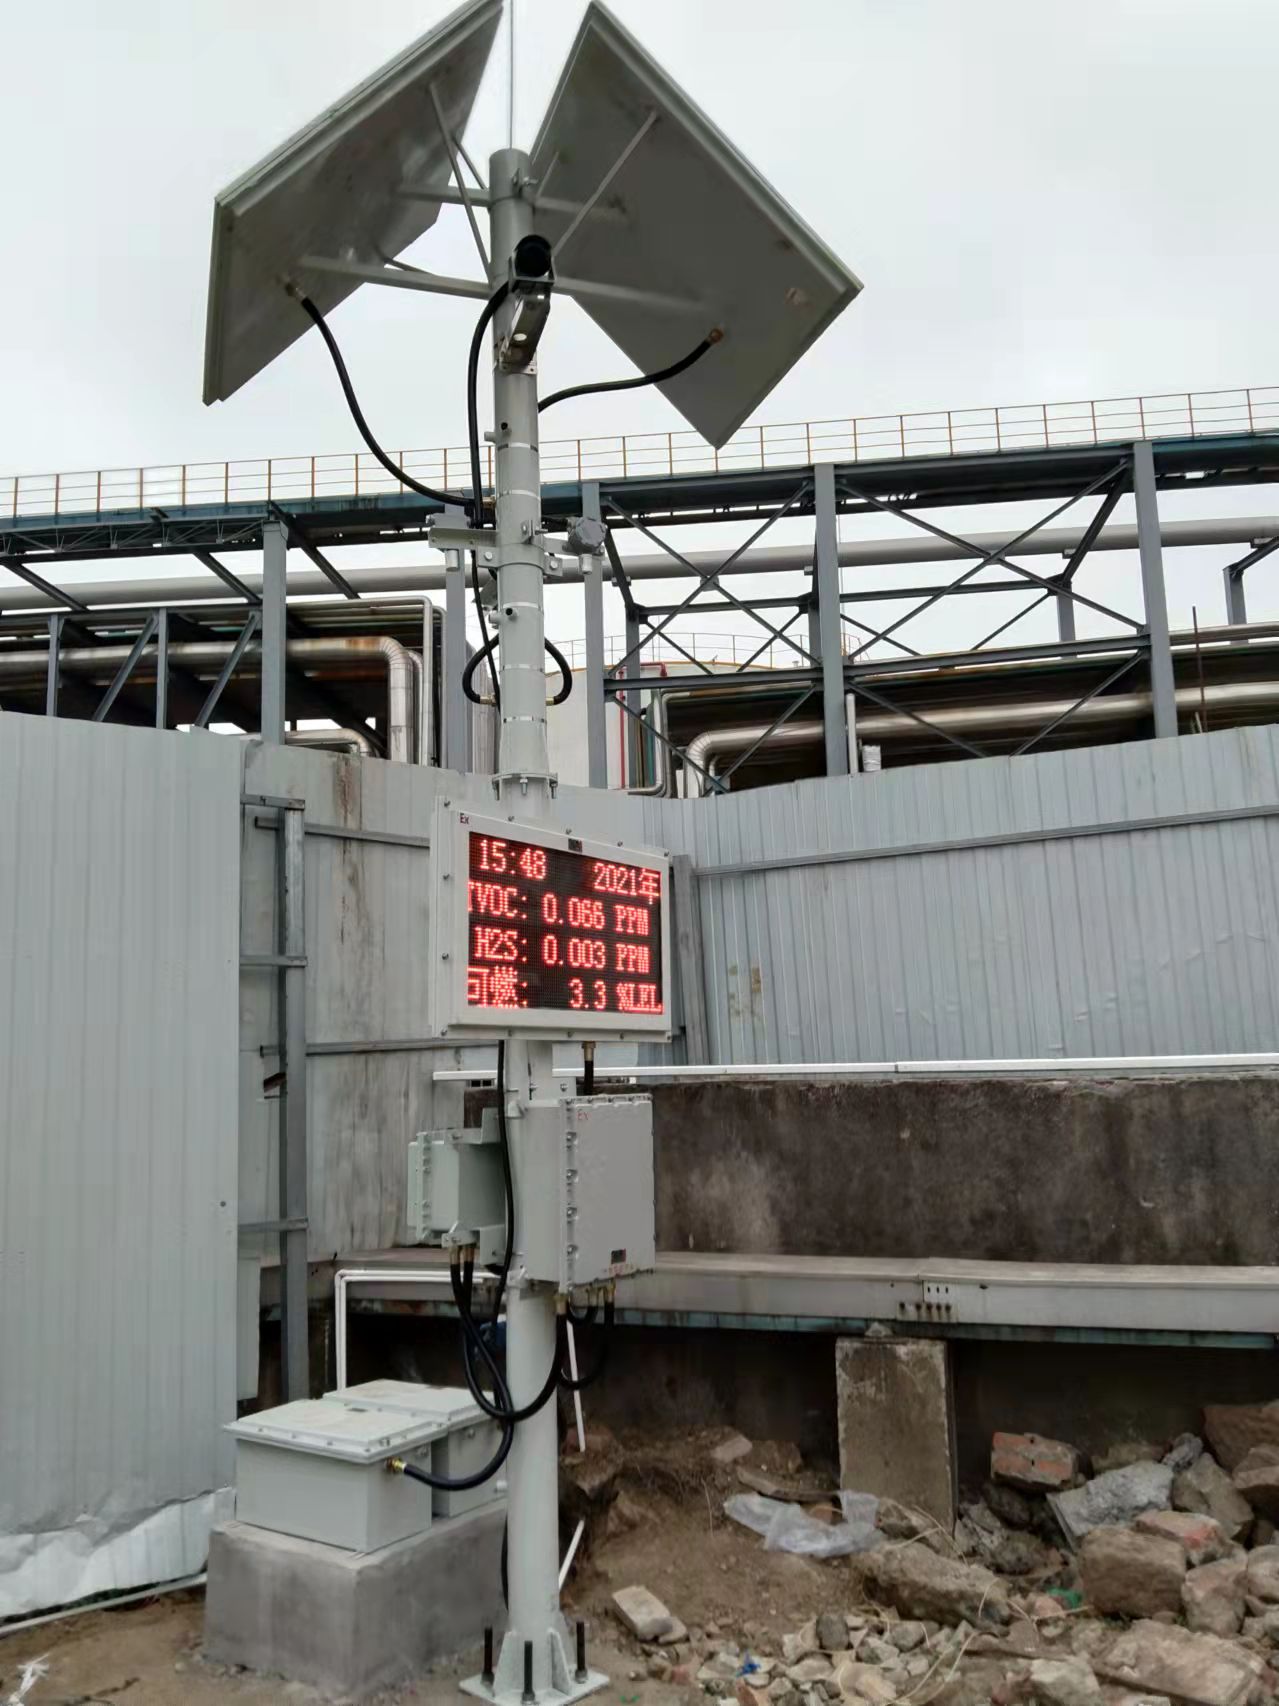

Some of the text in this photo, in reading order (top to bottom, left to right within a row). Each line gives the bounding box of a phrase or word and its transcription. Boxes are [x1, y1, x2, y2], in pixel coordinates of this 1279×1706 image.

[479, 839, 660, 905] 15:48 2021年
[542, 892, 606, 931] 0.066
[615, 904, 650, 936] PPM
[474, 926, 650, 974] H2S: 0.003 PPM
[568, 978, 607, 1010] 3.3
[616, 982, 664, 1014] %LEL
